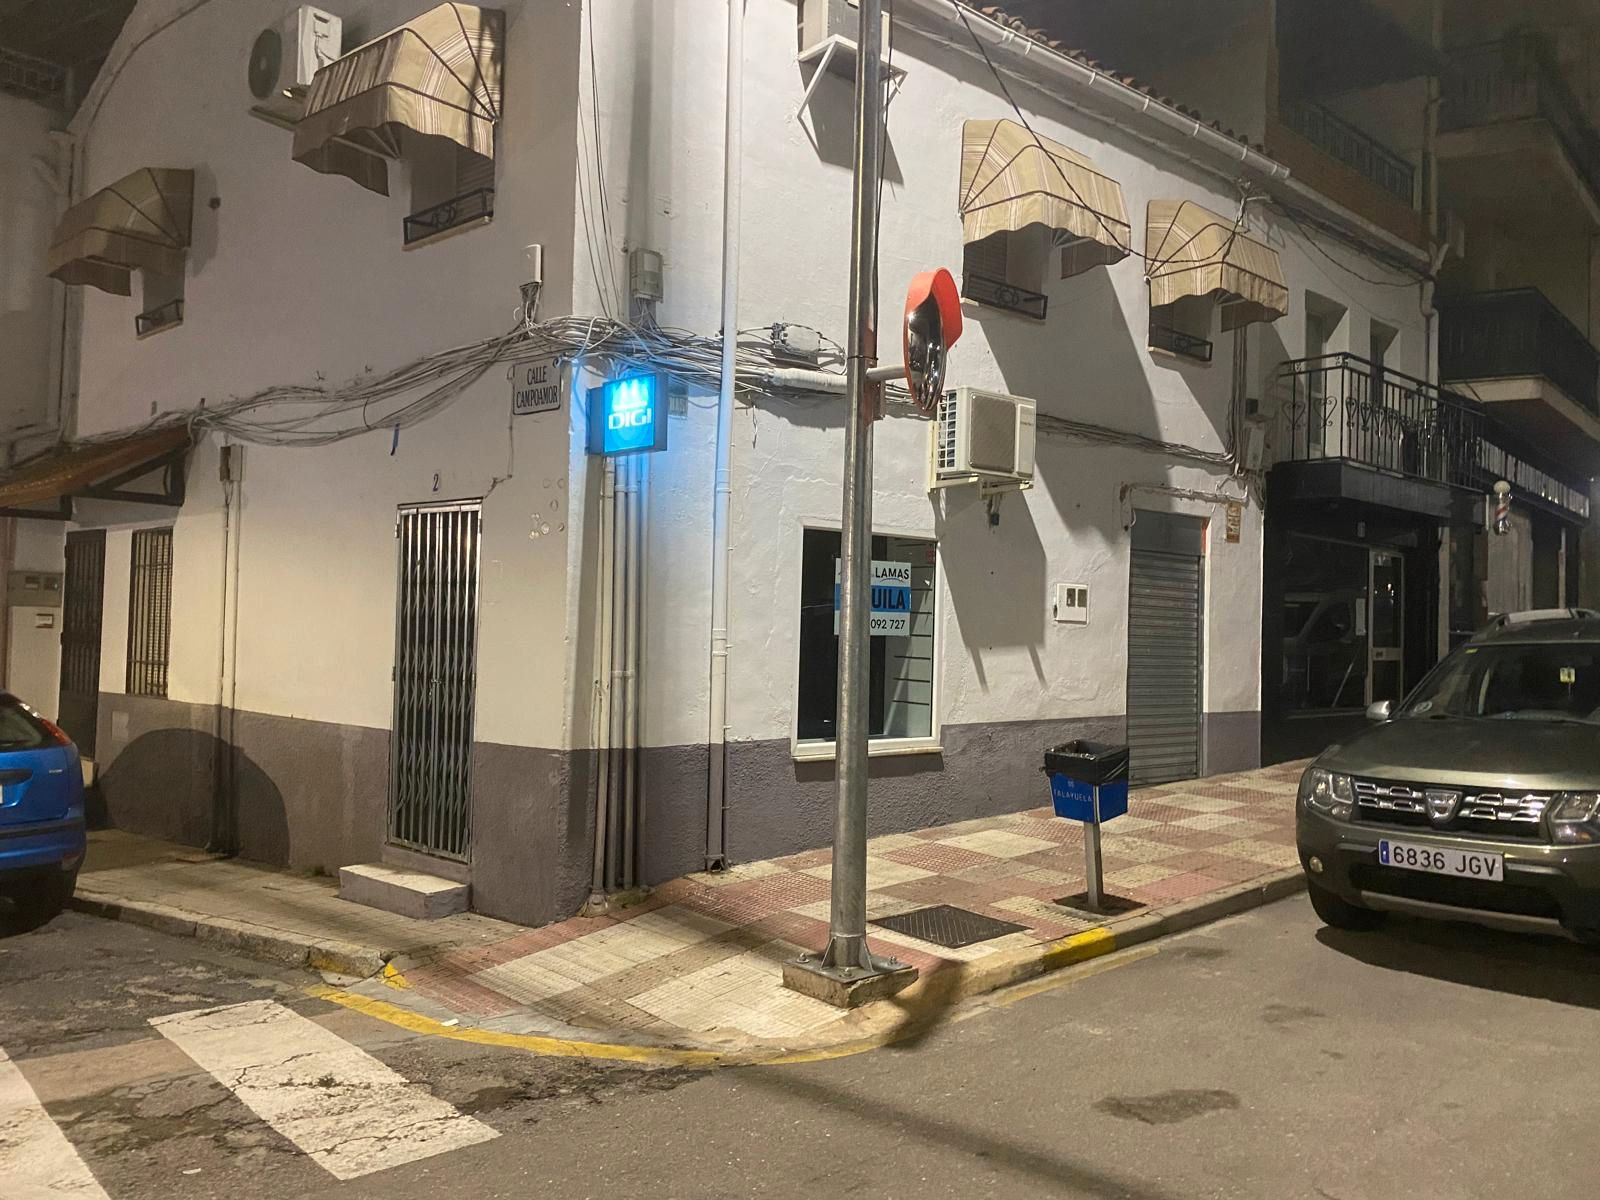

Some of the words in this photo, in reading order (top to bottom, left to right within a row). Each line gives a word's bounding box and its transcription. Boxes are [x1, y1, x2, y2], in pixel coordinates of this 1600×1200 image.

[527, 366, 547, 385] CALLE
[517, 386, 557, 408] CAMPOAMOR
[609, 408, 652, 430] DIGI
[433, 473, 438, 491] 2
[875, 568, 909, 579] LAMAS
[872, 588, 905, 609] UILA
[871, 619, 887, 629] 092
[889, 620, 905, 630] 727
[1393, 846, 1445, 870] 6836
[1455, 855, 1496, 877] JGV
